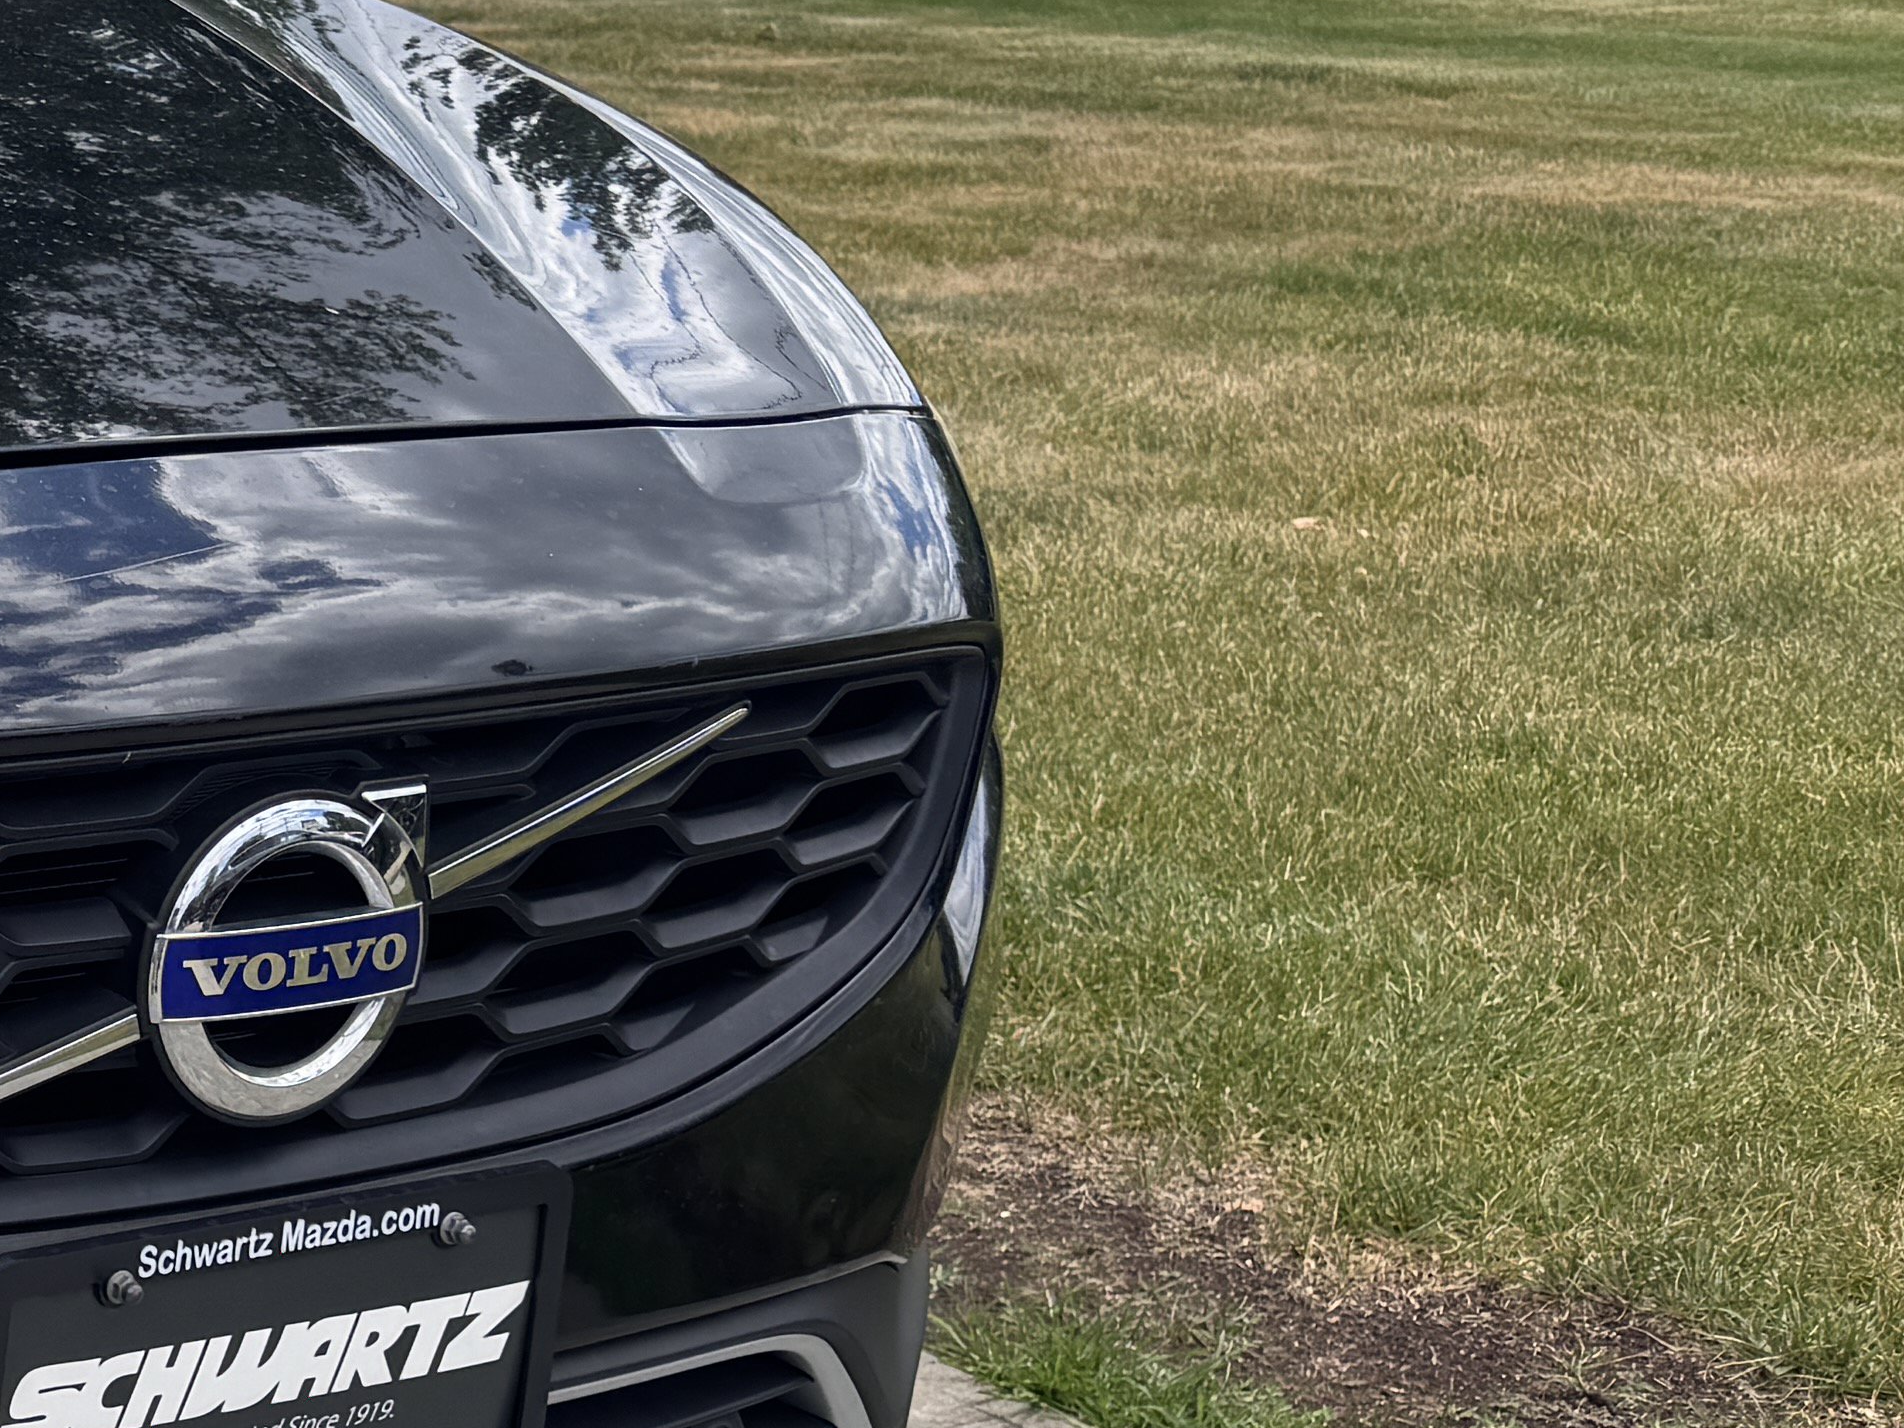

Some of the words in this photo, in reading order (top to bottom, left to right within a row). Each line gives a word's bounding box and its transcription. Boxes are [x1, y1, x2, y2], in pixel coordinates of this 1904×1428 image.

[183, 933, 407, 996] VOLVO
[137, 1227, 274, 1279] Schwartz
[280, 1202, 440, 1254] Mazda.com
[345, 1398, 395, 1427] 1919.
